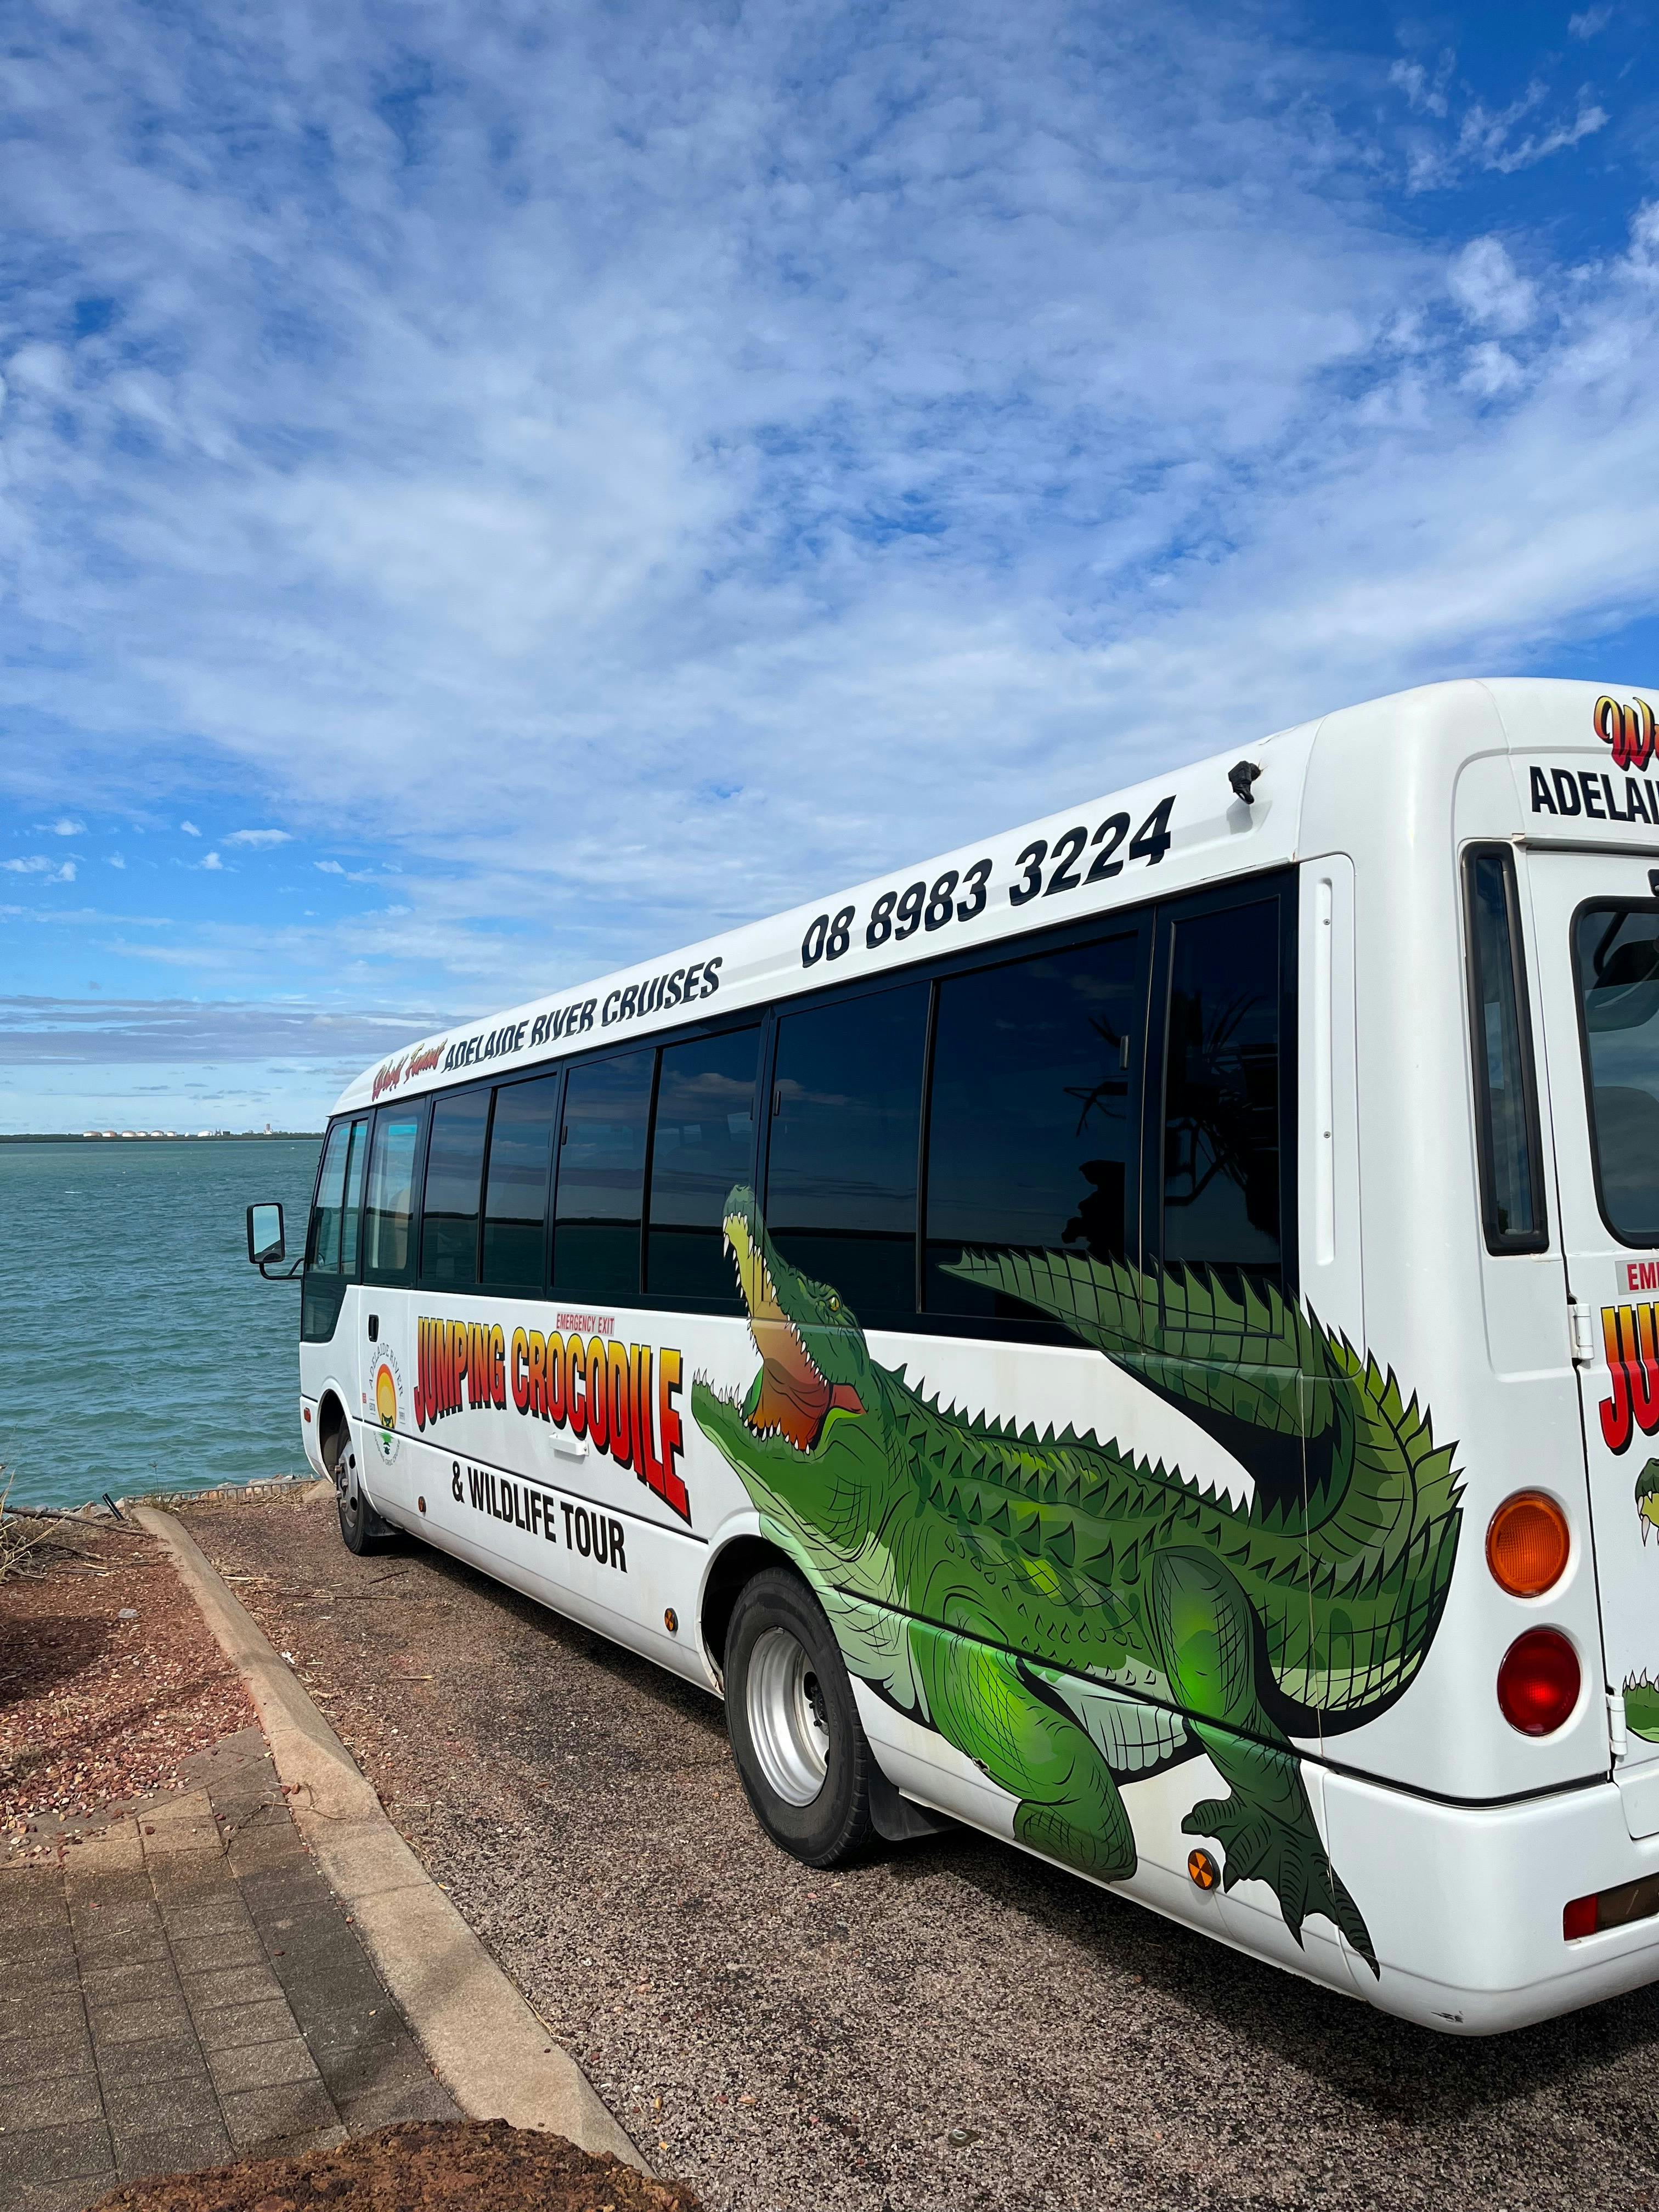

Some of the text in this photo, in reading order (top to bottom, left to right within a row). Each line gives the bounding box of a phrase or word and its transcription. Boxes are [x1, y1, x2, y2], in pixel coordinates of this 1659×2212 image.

[1593, 696, 1659, 771] W
[1530, 766, 1659, 825] ADELAI
[802, 794, 1176, 968] 08 8983 3224
[441, 1019, 529, 1073] ADELAIDE
[531, 998, 597, 1047] RIVER
[602, 957, 723, 1028] CRUISES
[1627, 1261, 1659, 1290] EM
[369, 1342, 403, 1397] ADELAIDE RIVER
[556, 1313, 614, 1334] EMERGENCY EXIT
[414, 1316, 692, 1529] JUMPING CROCODILE
[1599, 1301, 1659, 1455] JU
[452, 1460, 628, 1573] & WILDLIFE TOUR
